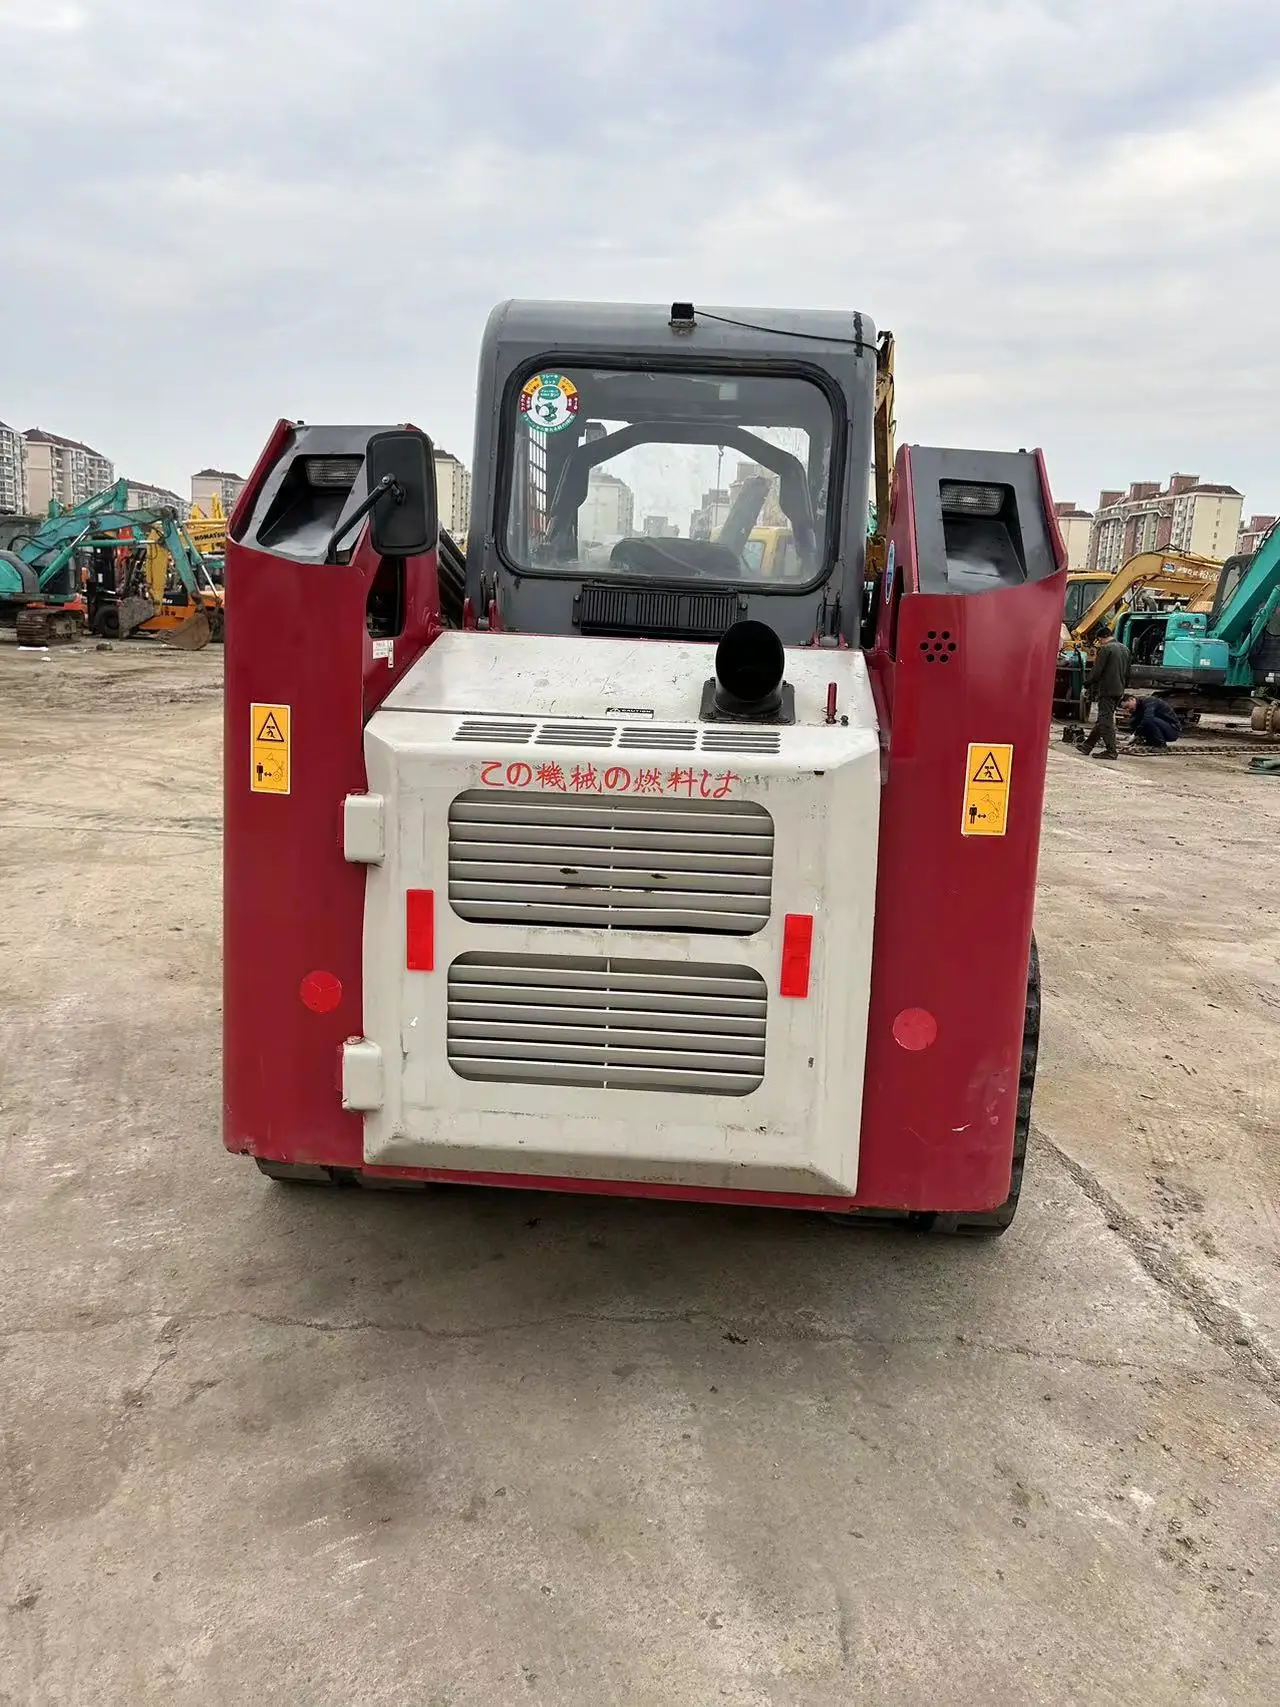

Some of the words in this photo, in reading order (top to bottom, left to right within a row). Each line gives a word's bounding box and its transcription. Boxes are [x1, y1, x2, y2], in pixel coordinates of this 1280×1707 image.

[194, 532, 225, 541] KOMATSU
[480, 760, 739, 798] この機械の燃料は
